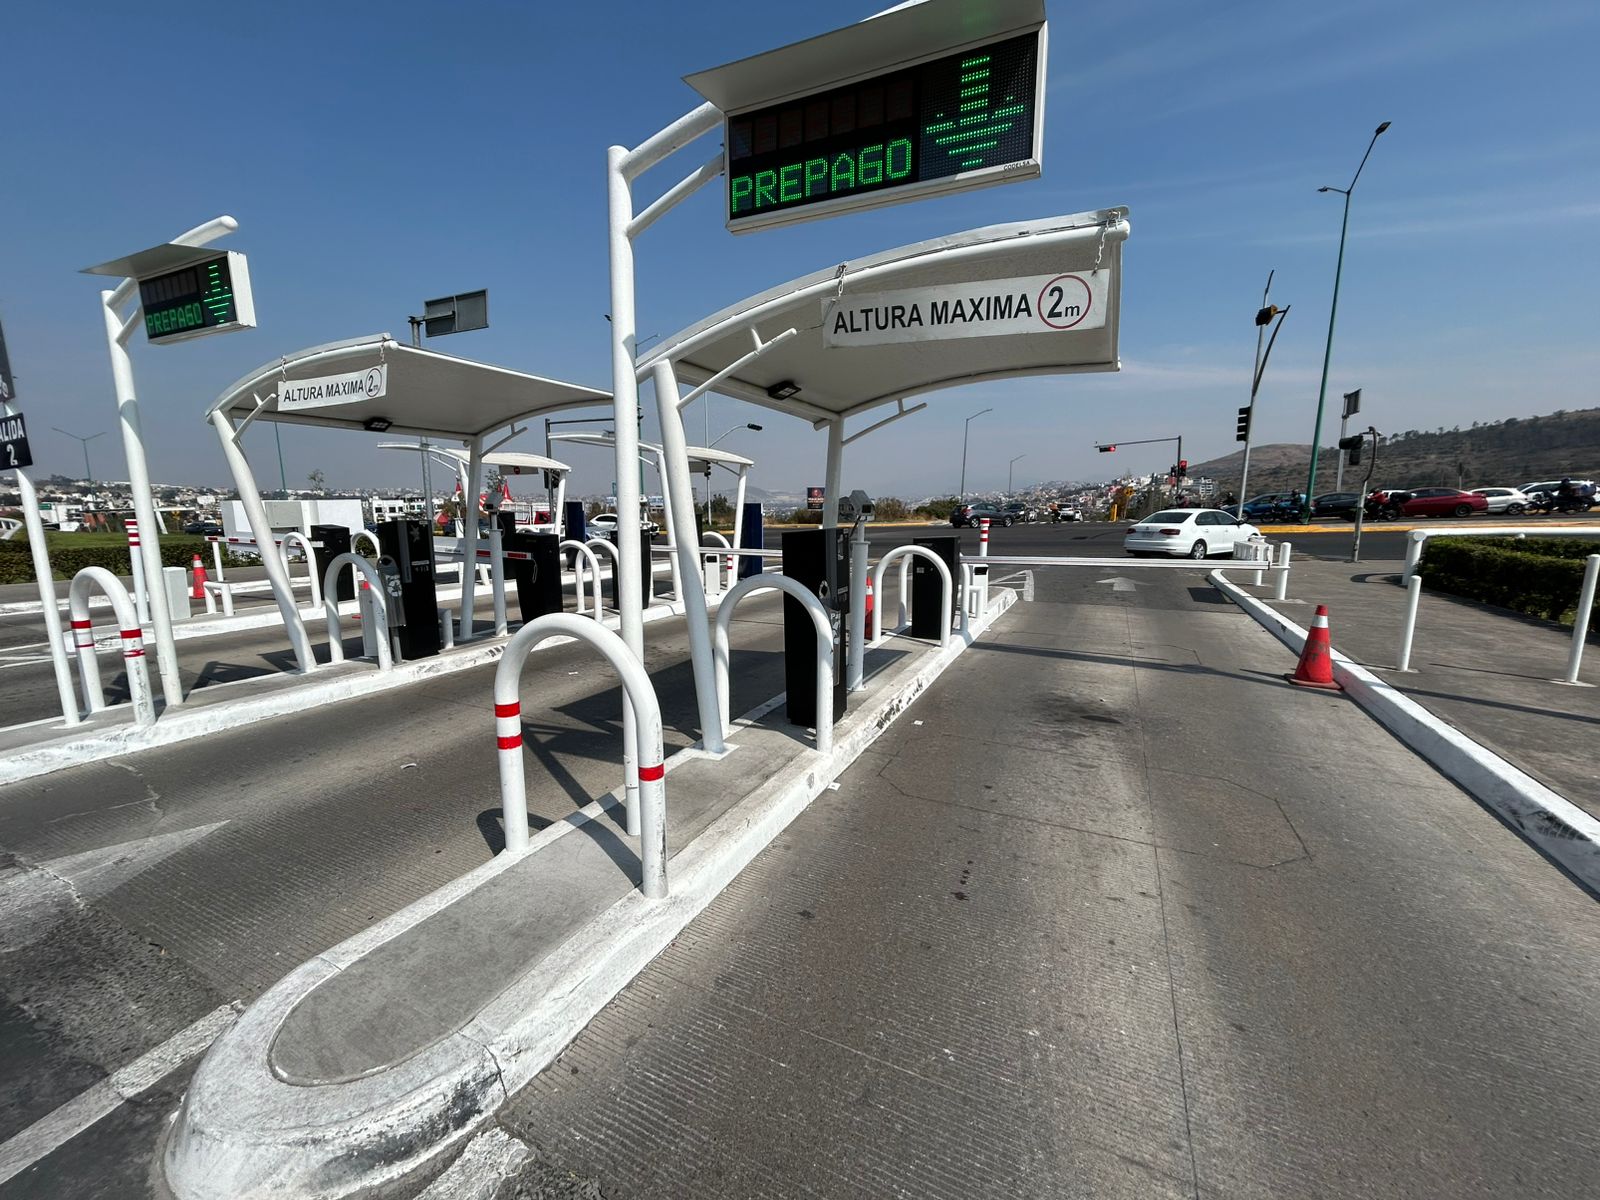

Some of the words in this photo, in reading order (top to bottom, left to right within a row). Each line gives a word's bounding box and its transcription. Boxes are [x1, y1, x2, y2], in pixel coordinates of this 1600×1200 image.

[731, 138, 912, 213] PREPAGO
[146, 302, 203, 336] PREPAGO
[833, 303, 924, 335] ALTURA
[930, 293, 1033, 326] MAXIMA
[283, 385, 324, 402] ALTURA
[326, 379, 365, 398] MAXIMA
[6, 443, 19, 466] 2
